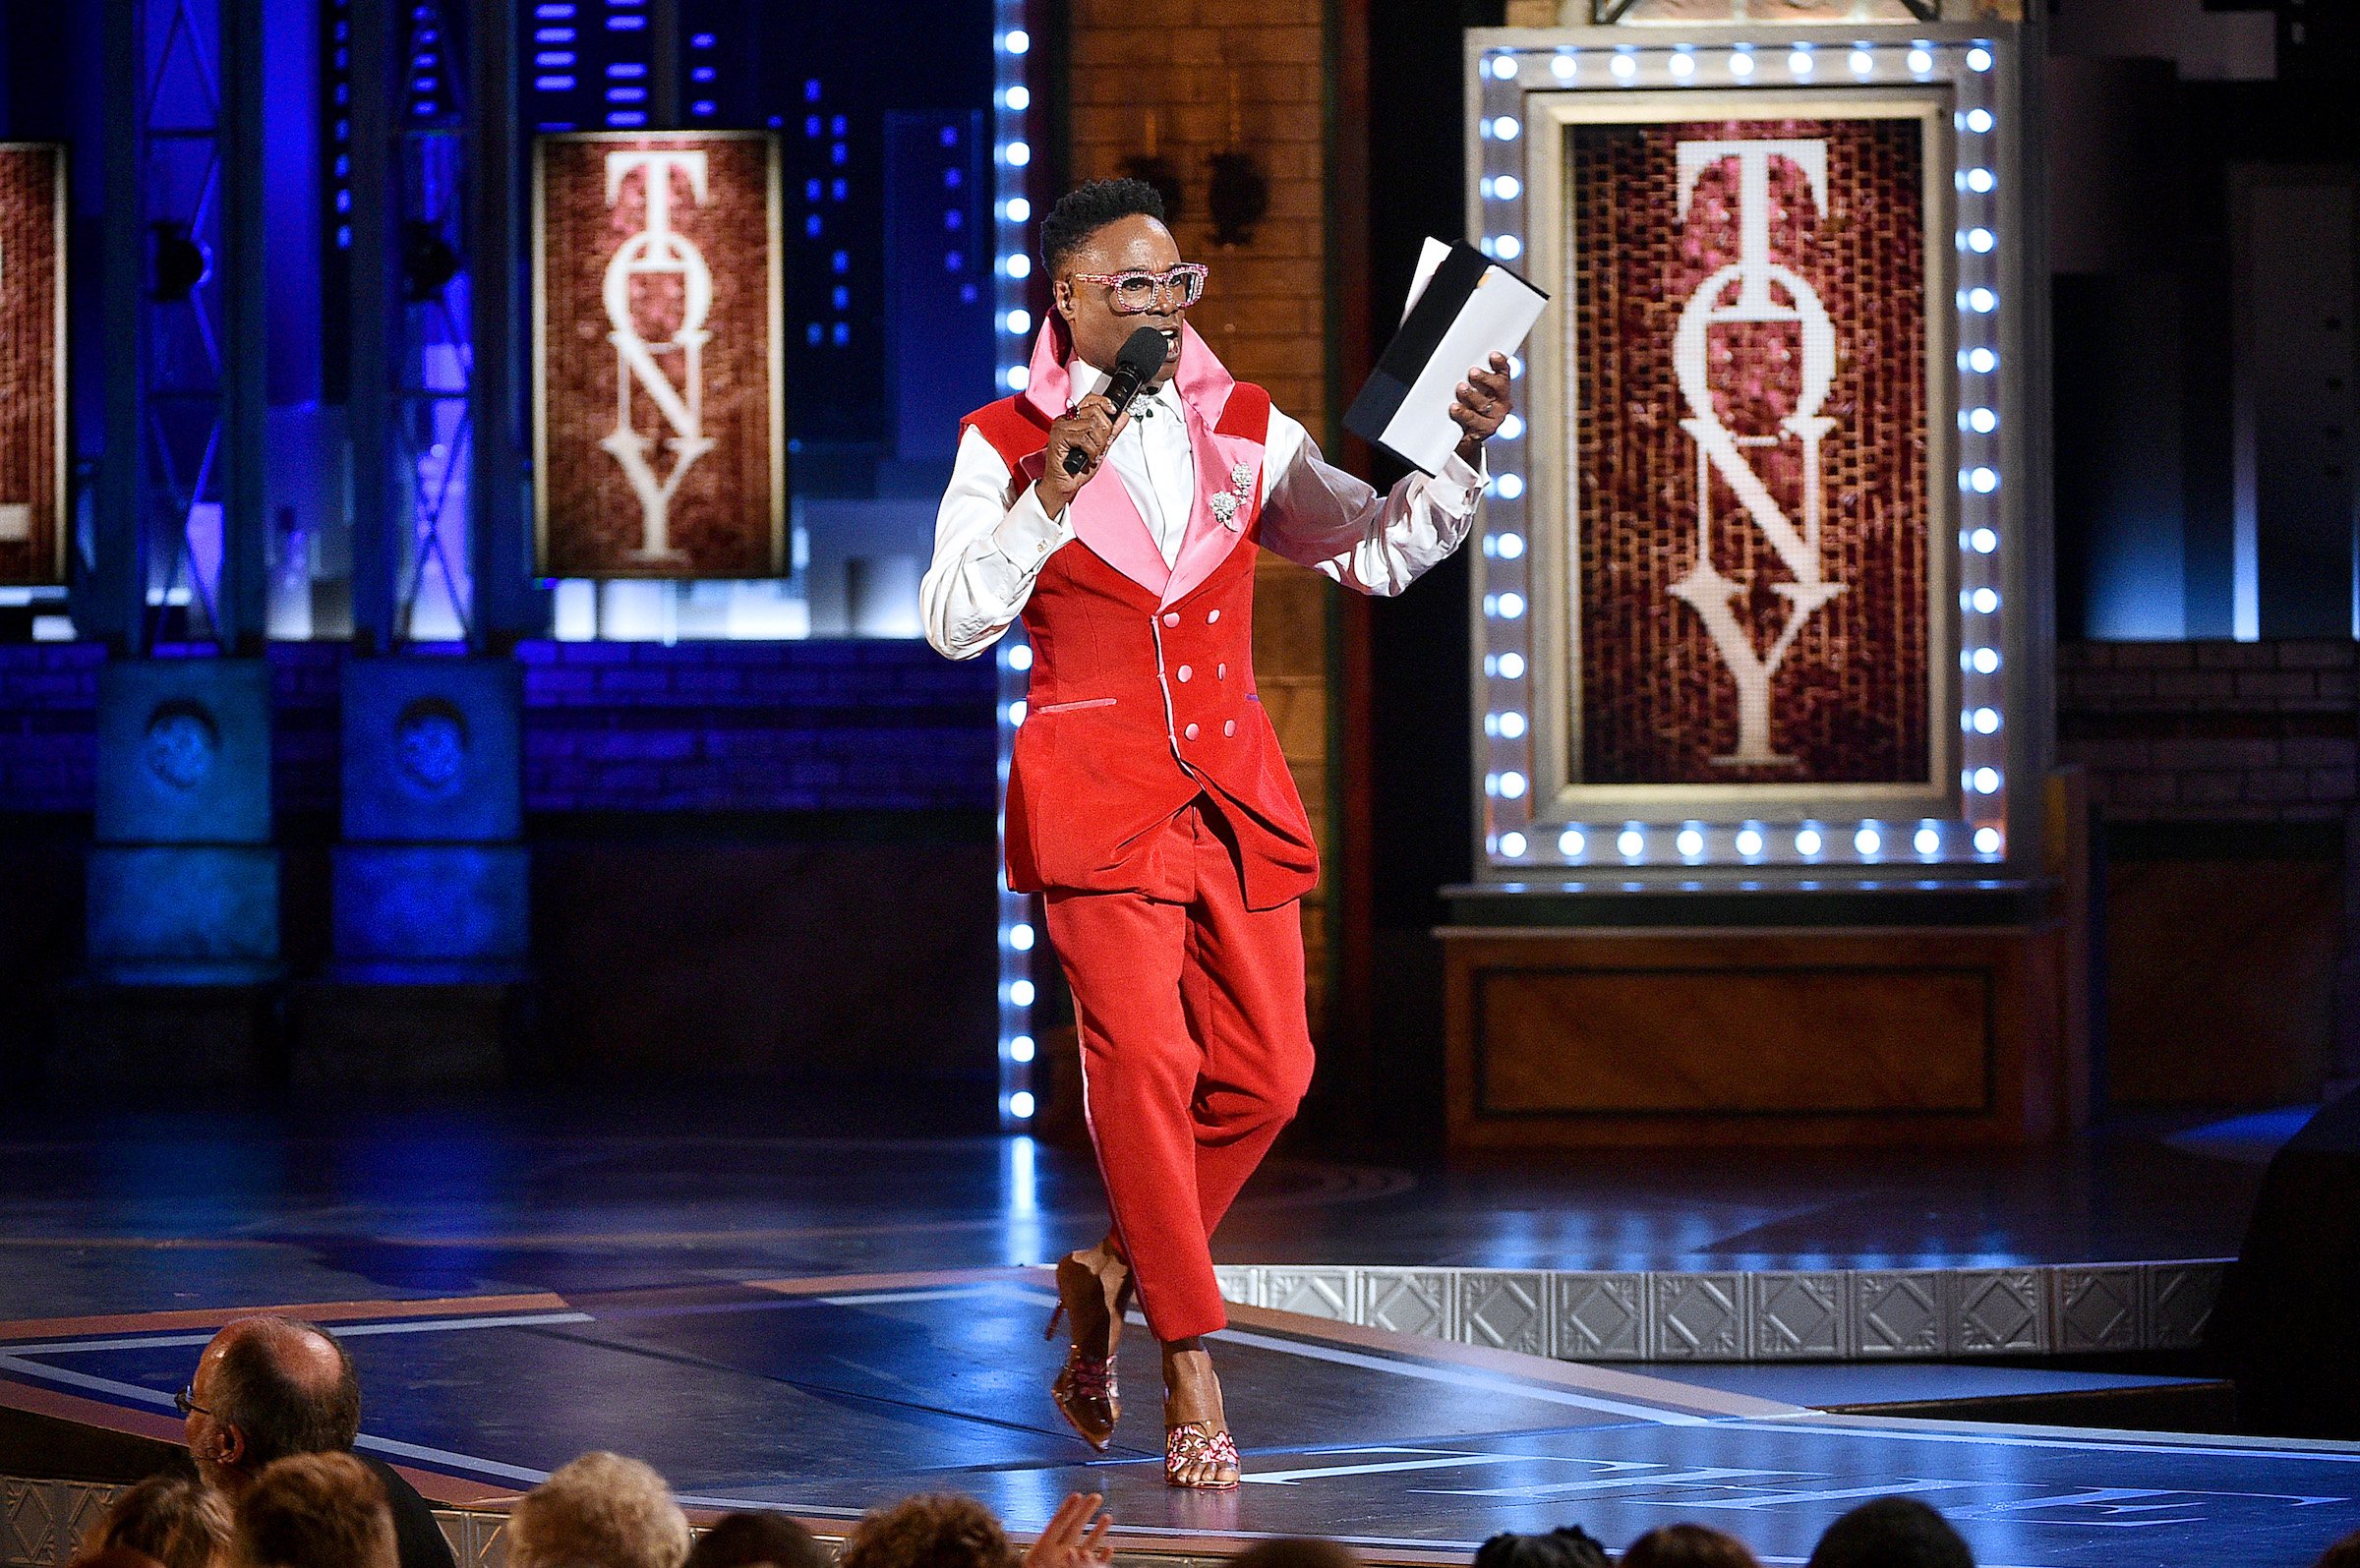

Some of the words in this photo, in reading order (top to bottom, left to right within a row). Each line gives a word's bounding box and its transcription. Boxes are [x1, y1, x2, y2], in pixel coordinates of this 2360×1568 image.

[599, 149, 718, 562] TONY
[1666, 139, 1850, 766] TONY
[1240, 1446, 2351, 1527] THE
